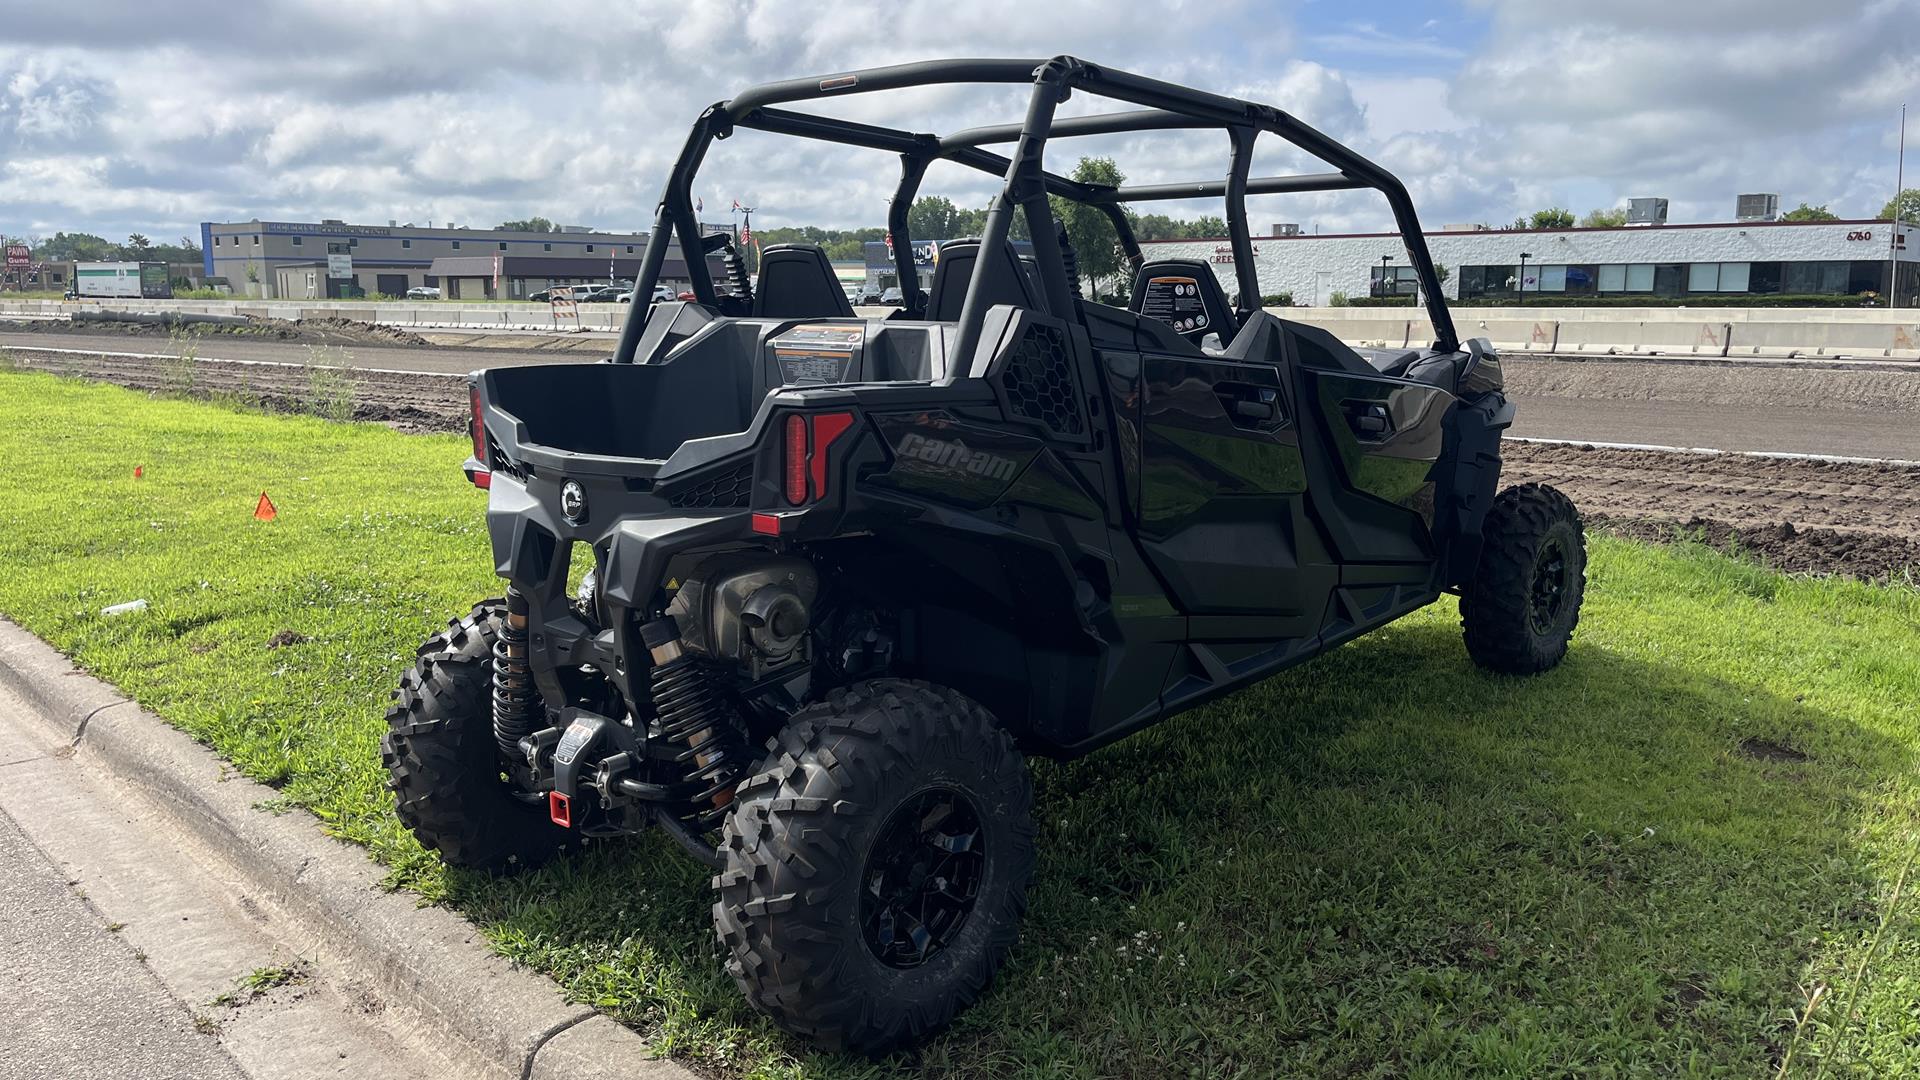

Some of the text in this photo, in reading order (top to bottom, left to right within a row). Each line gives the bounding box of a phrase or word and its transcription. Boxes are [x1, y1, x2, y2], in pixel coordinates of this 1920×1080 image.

[1847, 231, 1871, 241] 6760
[7, 246, 28, 256] PAWN
[1210, 255, 1235, 263] CREE
[897, 432, 1017, 481] can-am
